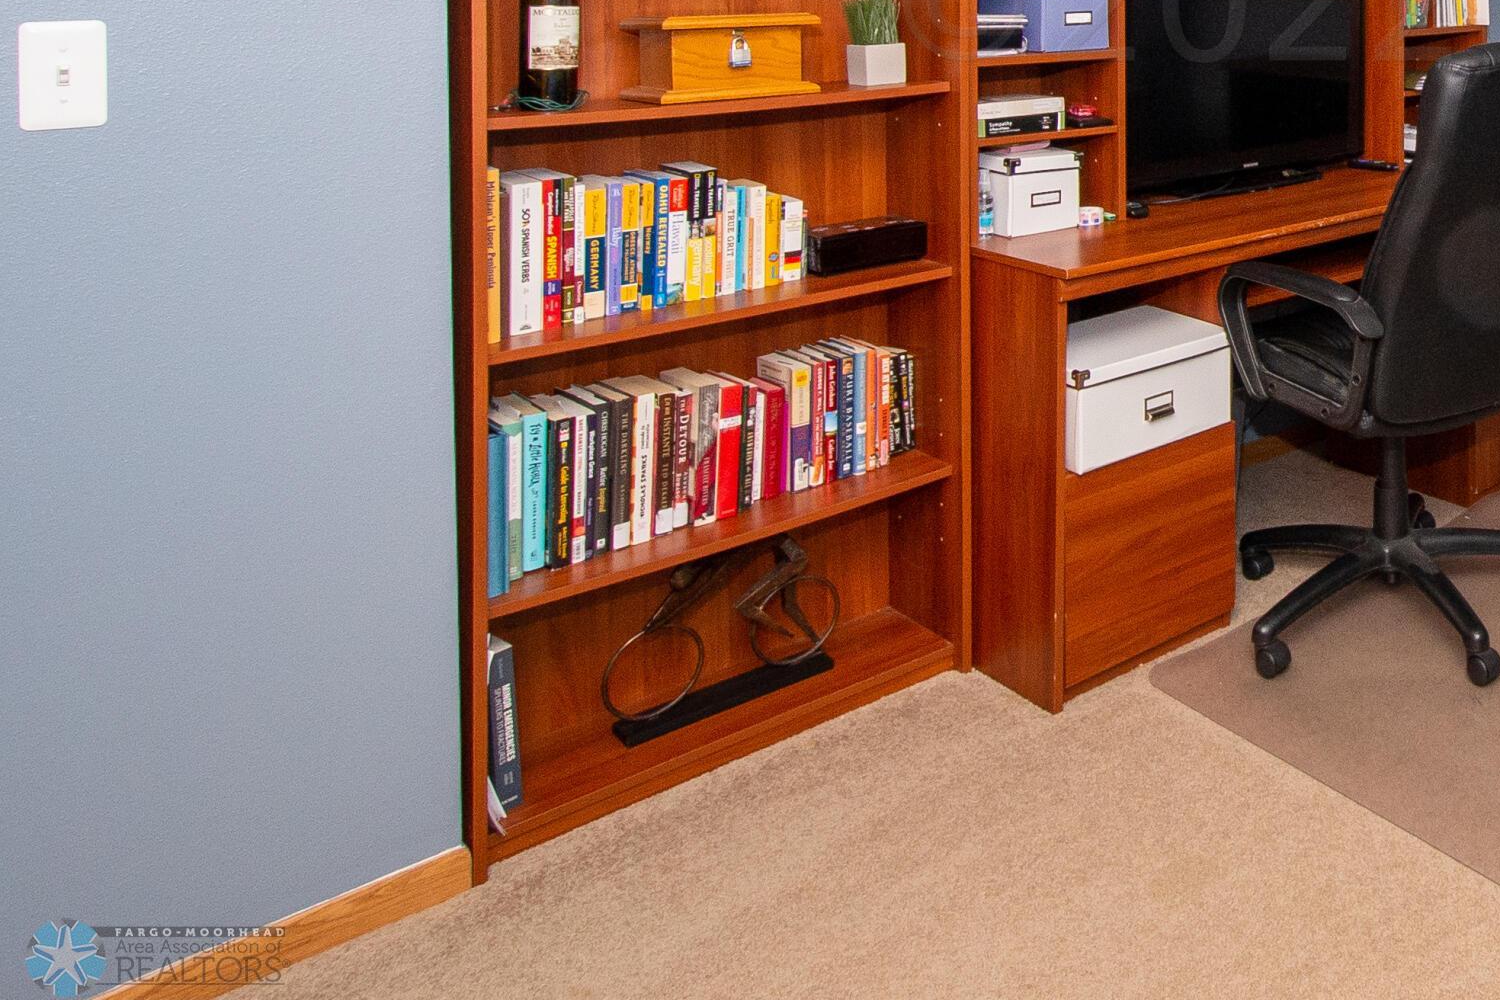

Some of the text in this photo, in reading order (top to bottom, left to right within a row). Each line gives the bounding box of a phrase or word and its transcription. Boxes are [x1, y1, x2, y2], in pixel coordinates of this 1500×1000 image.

[671, 213, 684, 254] Hawaii
[727, 209, 735, 233] TRUE
[487, 226, 495, 253] Upper
[521, 229, 530, 259] SPANISH
[644, 228, 652, 254] Norway
[658, 217, 667, 267] REVEALED
[488, 253, 496, 289] Peninsula
[521, 261, 530, 283] VERBS
[546, 236, 557, 279] SPANISH
[590, 240, 599, 289] GERMANY
[689, 240, 702, 286] germany
[600, 411, 608, 432] CHRIS
[621, 413, 629, 430] THE
[600, 433, 608, 458] HOGAN
[662, 417, 672, 458] INSTANTE
[678, 414, 689, 464] DETOUR
[620, 432, 628, 475] DARKLING
[560, 466, 569, 485] Guide
[599, 466, 607, 487] Retire
[557, 493, 568, 524] Investing
[495, 688, 504, 721] SPLINTERS
[502, 683, 513, 709] MINOR
[496, 721, 504, 730] TO
[504, 710, 516, 762] EMERGENCIES
[497, 730, 505, 765] FRACTURES
